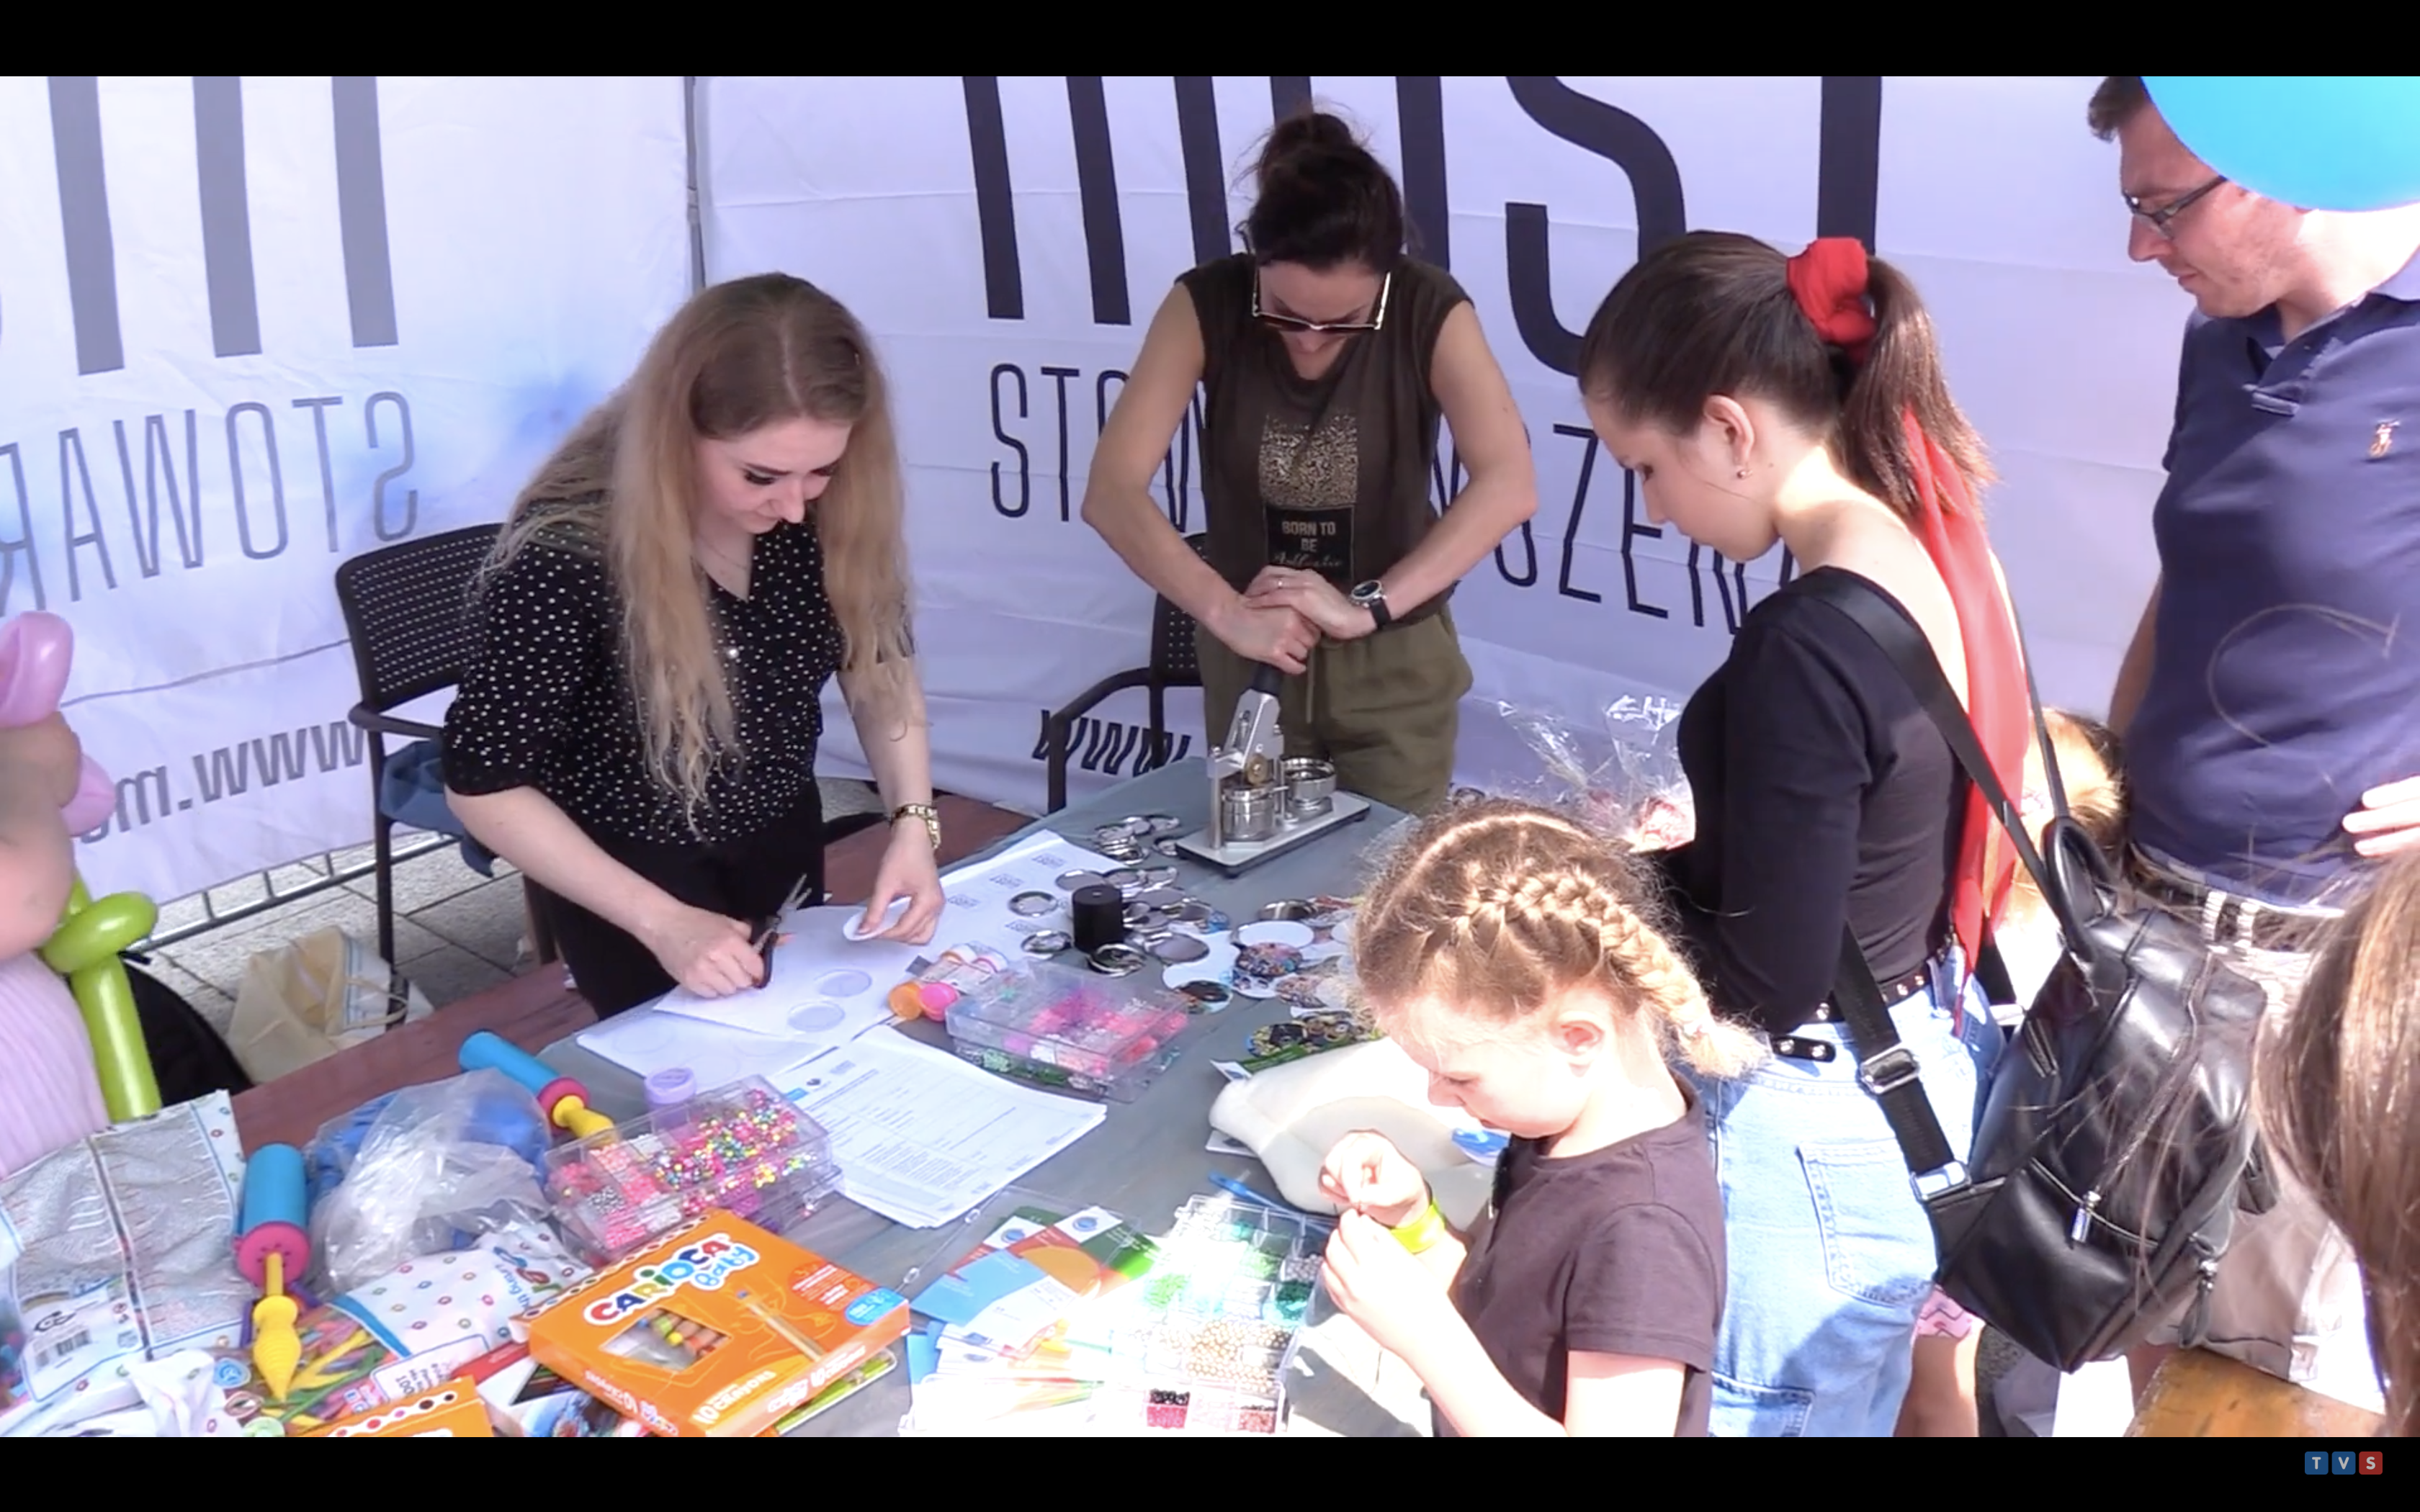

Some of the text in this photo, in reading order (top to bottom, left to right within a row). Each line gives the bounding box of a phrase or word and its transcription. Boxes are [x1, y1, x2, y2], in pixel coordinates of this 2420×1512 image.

[1282, 521, 1336, 536] BORN TO
[1301, 538, 1318, 552] BE
[694, 1246, 756, 1287] Baby
[692, 1404, 720, 1424] 10
